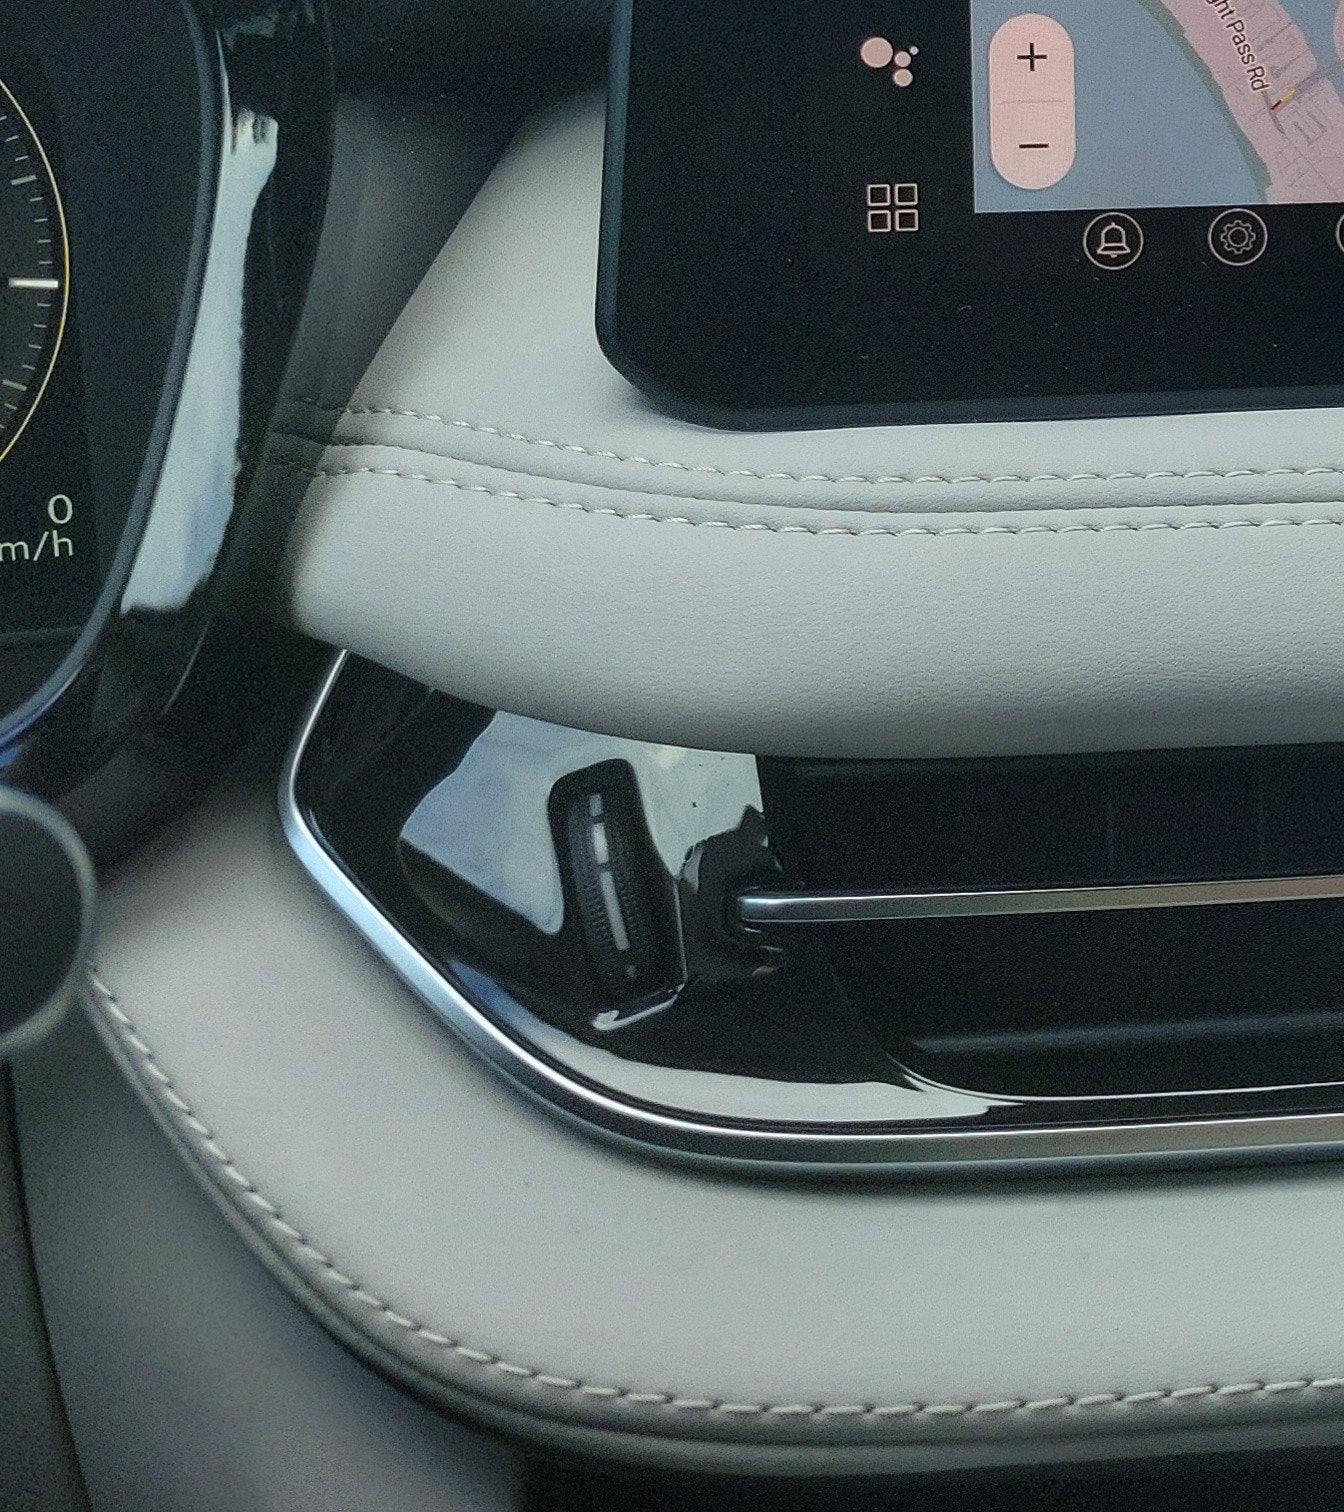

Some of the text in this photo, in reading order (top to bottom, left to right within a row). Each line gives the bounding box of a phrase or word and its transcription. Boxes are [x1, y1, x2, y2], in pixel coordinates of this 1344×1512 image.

[1226, 19, 1255, 65] Pass
[1246, 65, 1270, 91] Rd
[48, 494, 73, 524] 0
